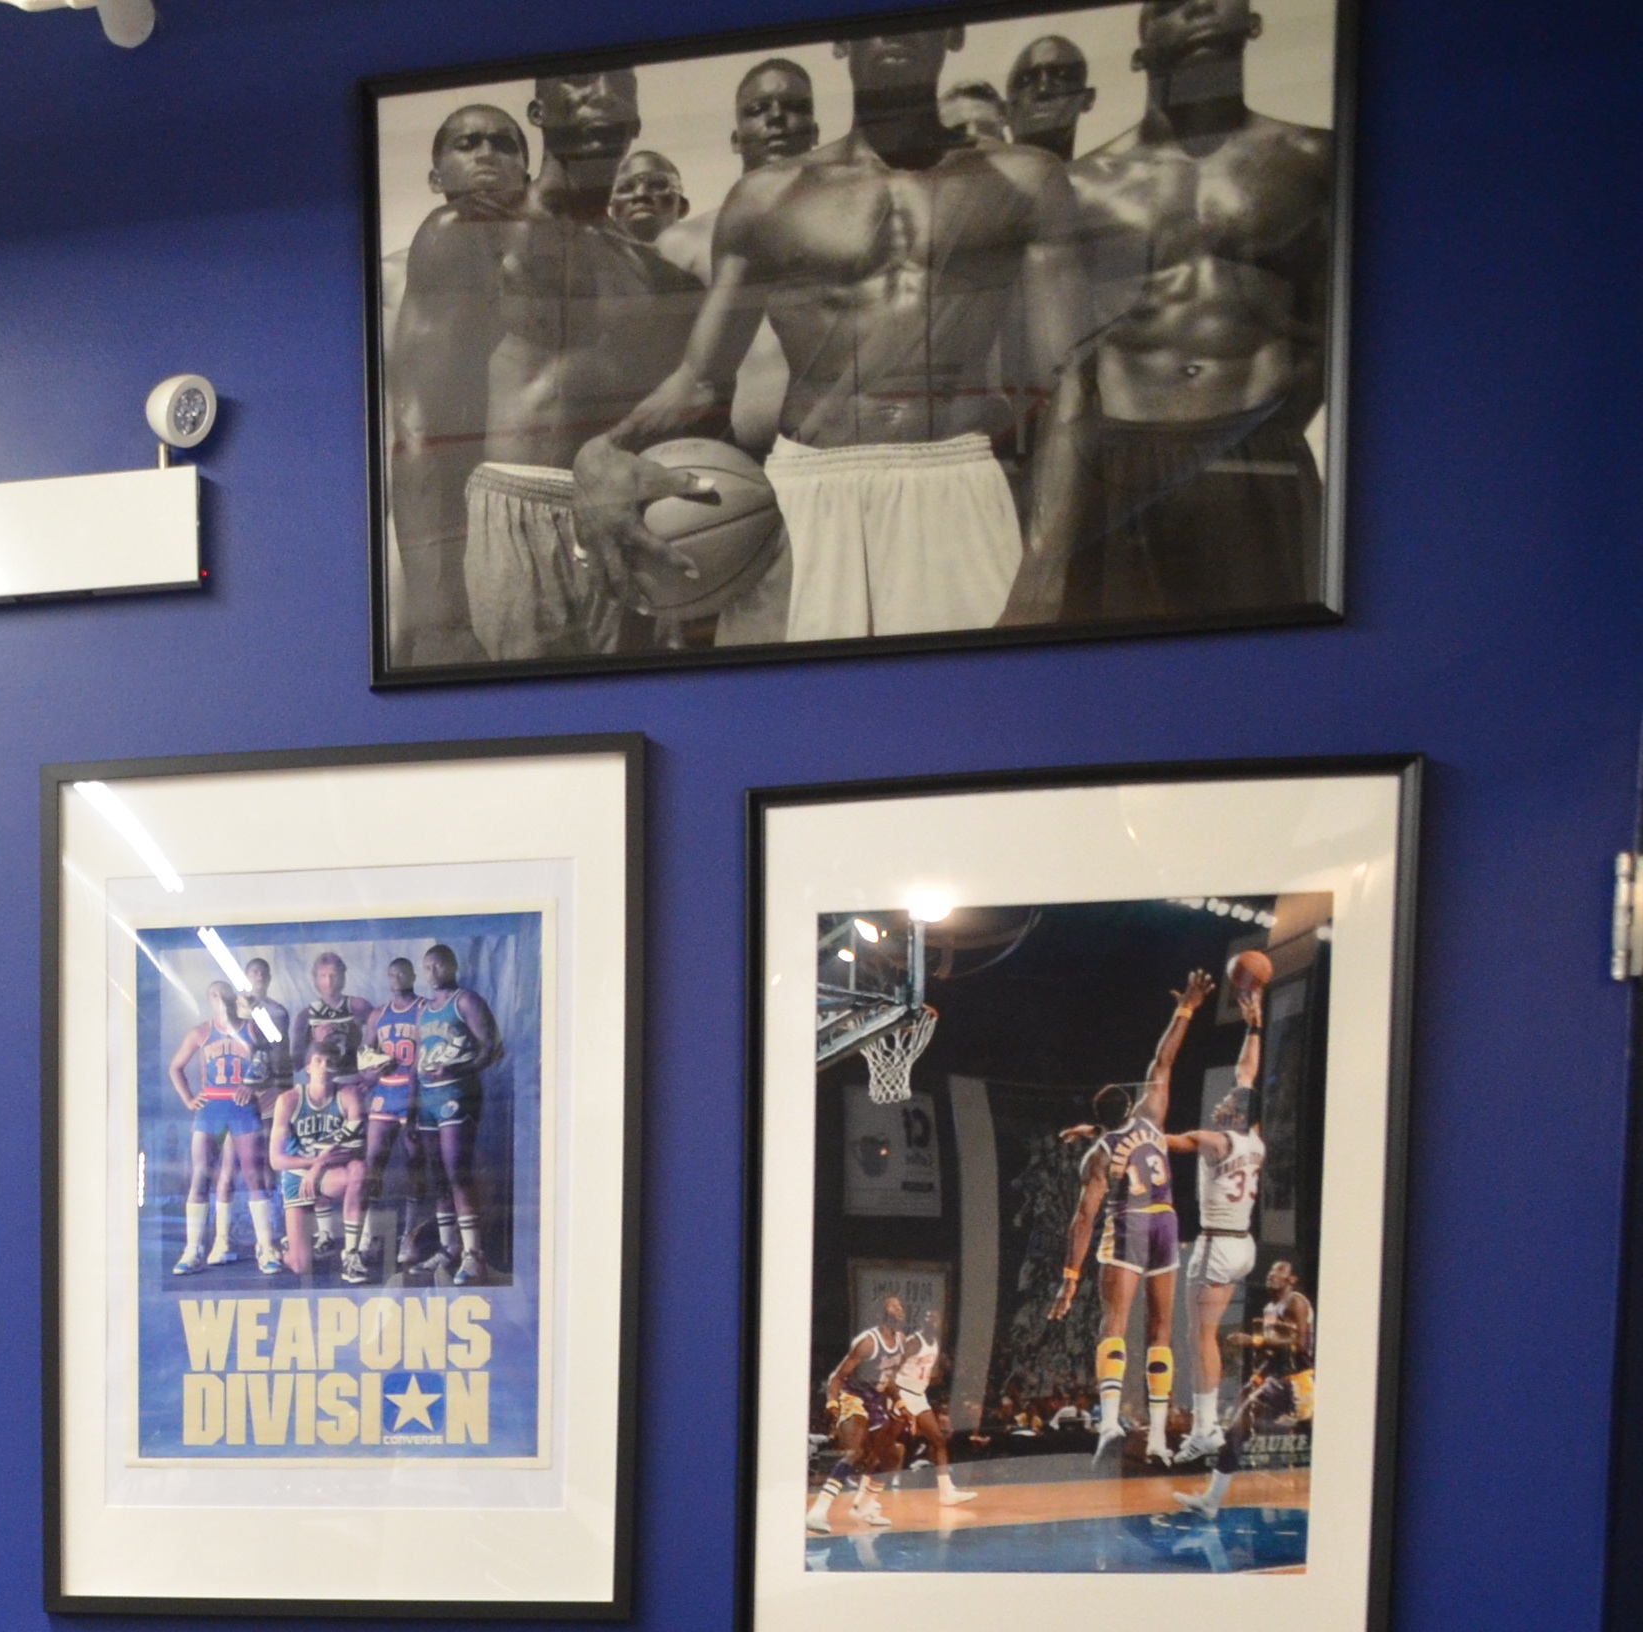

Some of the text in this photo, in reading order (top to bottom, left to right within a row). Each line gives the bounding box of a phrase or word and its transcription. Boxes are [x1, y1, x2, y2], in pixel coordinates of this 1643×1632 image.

[215, 1057, 241, 1084] 11
[1126, 1154, 1167, 1196] 13
[179, 1295, 492, 1371] WEAPONS
[183, 1371, 490, 1445] DIVISIN
[383, 1435, 444, 1445] CONVERSE
